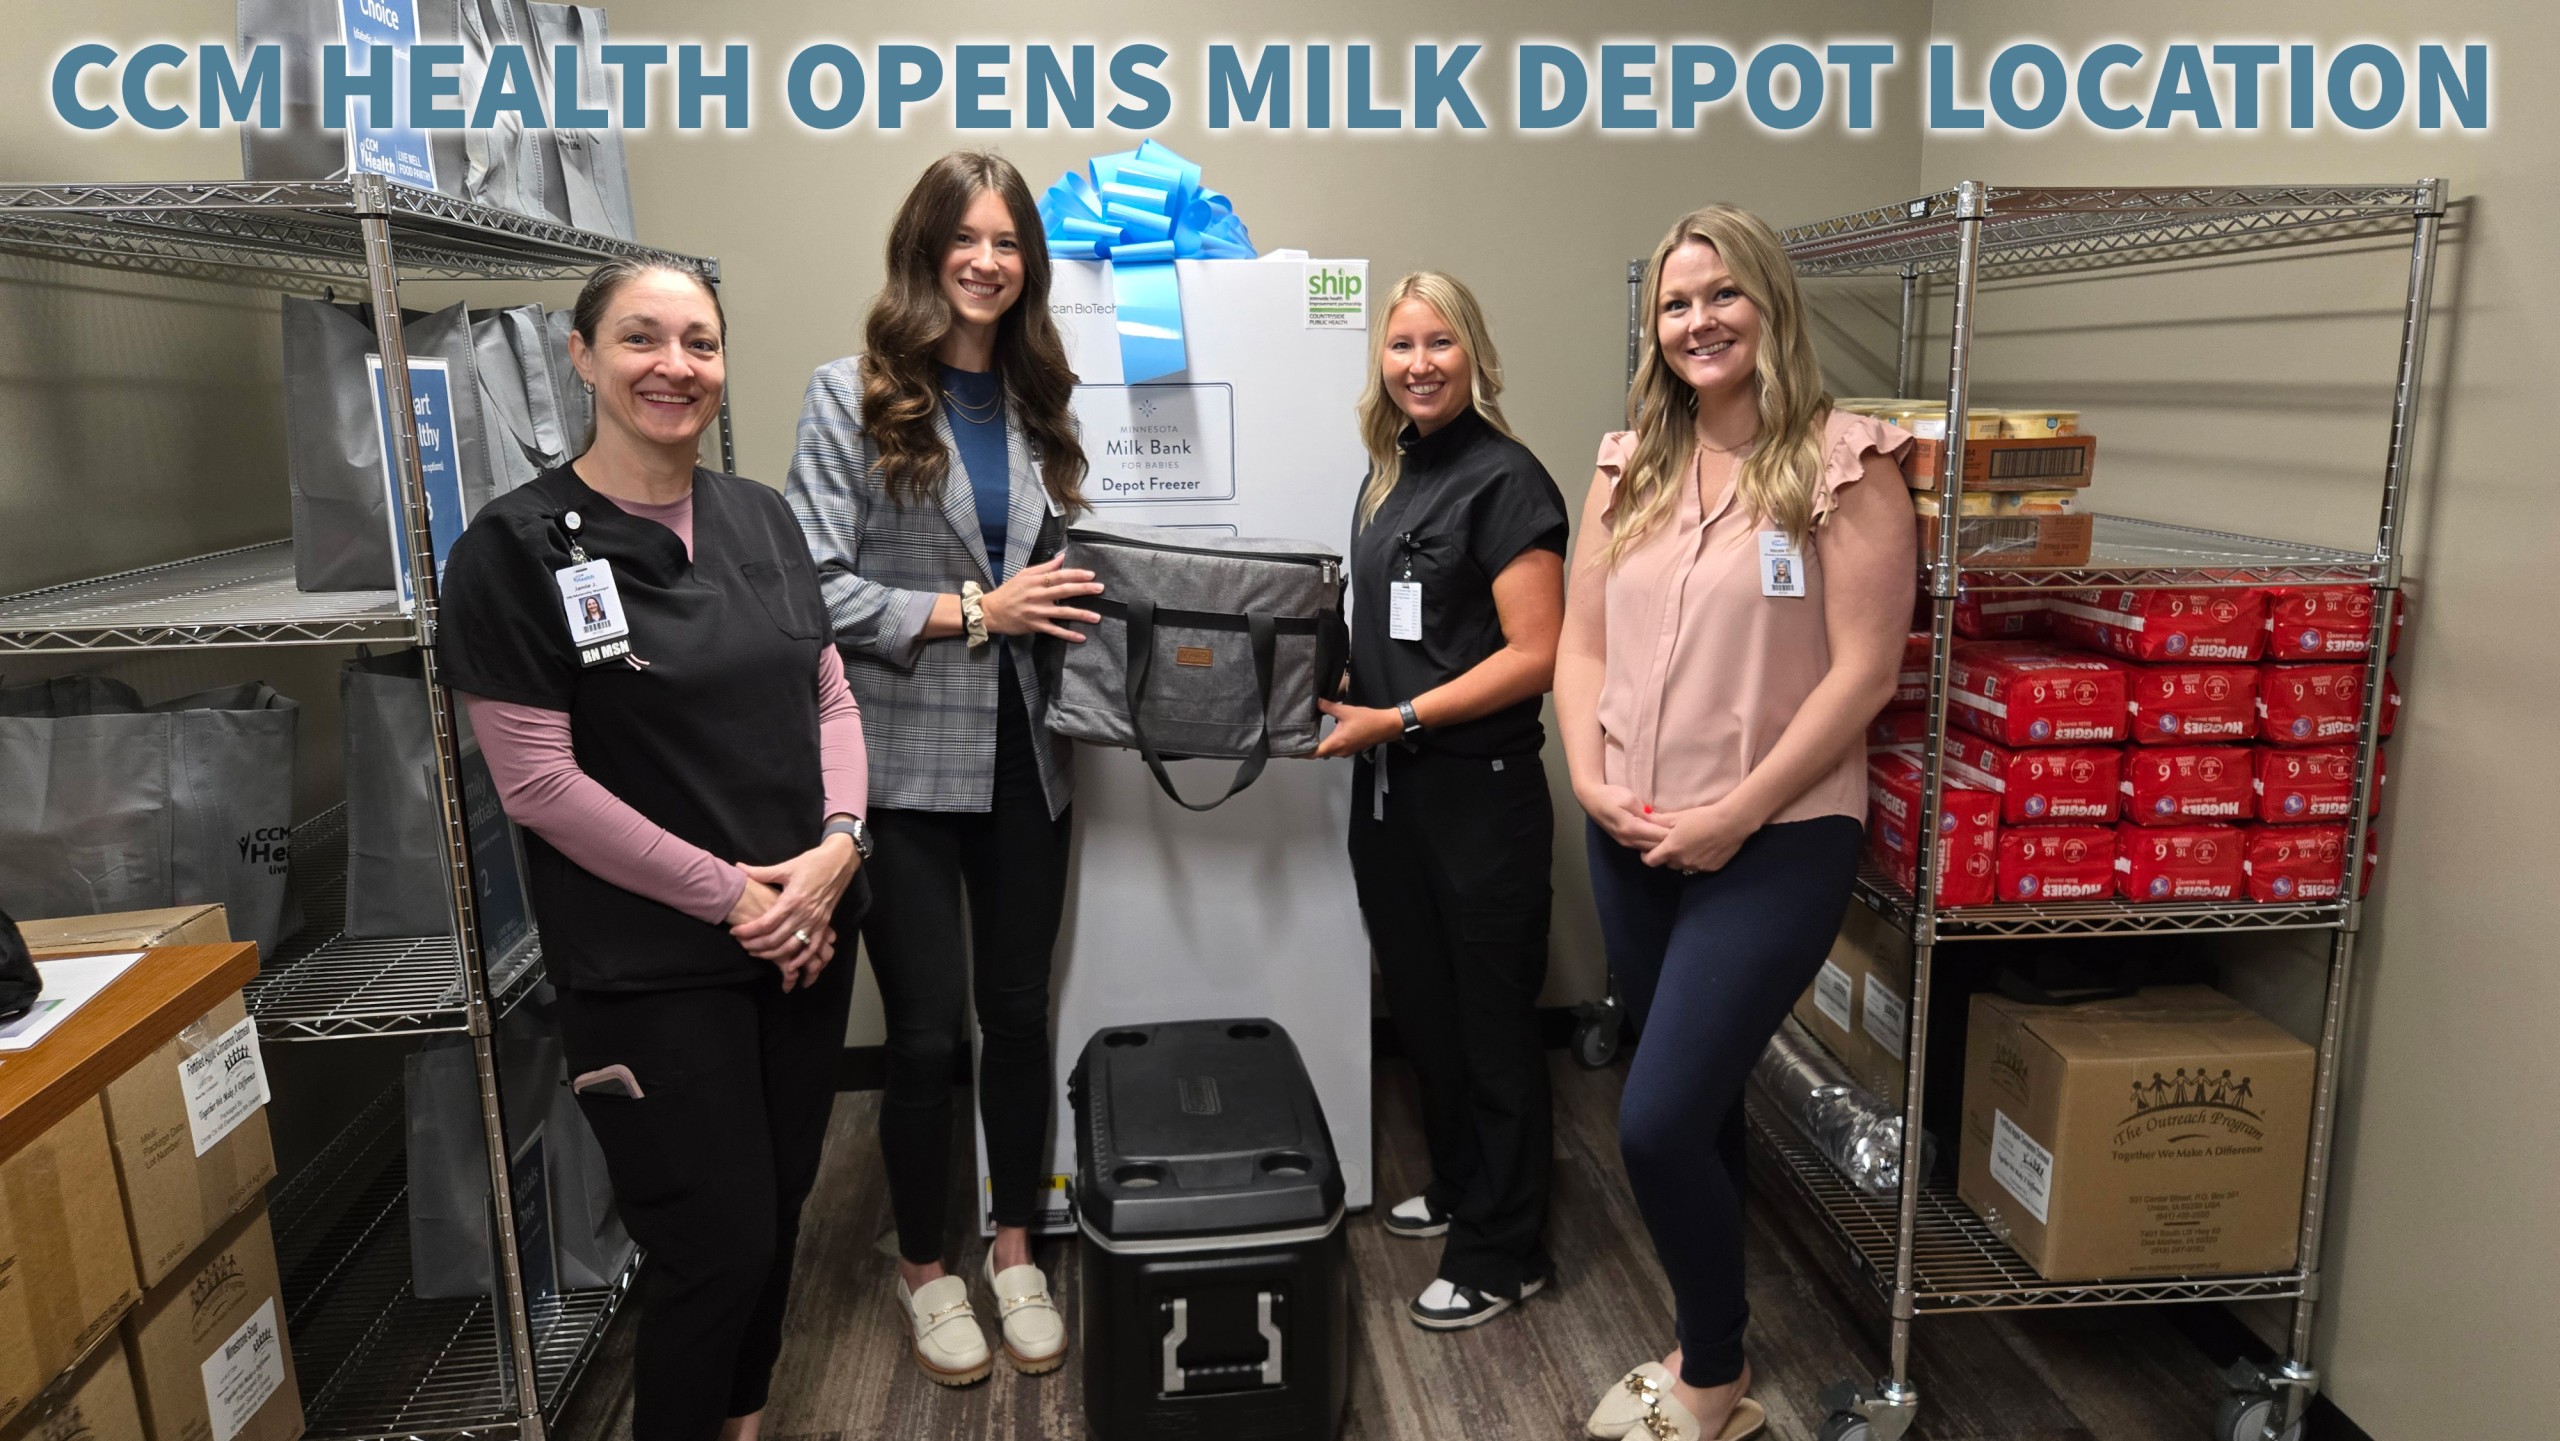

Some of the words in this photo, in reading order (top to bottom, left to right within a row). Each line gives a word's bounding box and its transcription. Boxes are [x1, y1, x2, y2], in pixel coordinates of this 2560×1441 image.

[365, 137, 379, 153] CCM
[364, 151, 396, 176] Health
[397, 150, 407, 162] LIVE
[407, 152, 421, 168] WELL
[398, 163, 414, 178] FOOD
[413, 165, 432, 183] PANTRY
[1309, 268, 1362, 300] ship
[1051, 304, 1074, 314] can
[412, 393, 432, 416] art
[417, 422, 440, 452] lthy
[1120, 425, 1179, 434] MINNESOTA
[1106, 439, 1145, 456] Milk
[1150, 439, 1192, 455] Bank
[1121, 462, 1142, 470] FOR
[1145, 461, 1180, 469] BABIES
[1102, 477, 1145, 495] Depot
[1150, 477, 1201, 490] Freezer
[2170, 600, 2183, 617] 6
[2191, 605, 2203, 615] 16
[2305, 599, 2317, 616] 6
[2326, 602, 2338, 611] 16
[582, 648, 601, 664] RN
[601, 639, 630, 658] MSN
[2189, 646, 2248, 659] HUGGIES
[2326, 640, 2369, 652] GGIES
[2033, 686, 2045, 704] 6
[2055, 689, 2066, 699] 16
[2162, 680, 2175, 699] 6
[2184, 684, 2196, 694] 16
[2294, 684, 2304, 701] 6
[2315, 686, 2327, 695] 16
[2055, 726, 2114, 740] HUGGIES
[2184, 721, 2243, 735] HUGGIES
[2317, 721, 2361, 737] GGIES
[2030, 763, 2043, 780] 6
[2052, 767, 2064, 777] 16
[2158, 764, 2171, 782] 6
[2180, 767, 2191, 776] 16
[2288, 761, 2300, 778] 6
[2309, 764, 2321, 774] 16
[468, 799, 499, 831] entials
[2050, 804, 2107, 817] HUGGIES
[2181, 801, 2239, 815] HUGGIES
[2309, 802, 2350, 815] GGIES
[1972, 813, 1987, 826] 6
[255, 826, 291, 841] CCM
[2023, 843, 2035, 860] 6
[2045, 847, 2055, 857] 16
[2155, 843, 2167, 861] 6
[2176, 848, 2186, 857] 16
[2278, 846, 2290, 862] 6
[2300, 848, 2311, 858] 16
[480, 868, 492, 898] 2
[2042, 883, 2101, 897] HUGGIES
[2174, 885, 2231, 897] HUGGIES
[2298, 885, 2342, 897] GGIES
[2113, 1125, 2143, 1146] The
[2146, 1109, 2207, 1132] Outreach
[2210, 1111, 2264, 1141] Program
[143, 1133, 170, 1154] Package
[2112, 1149, 2155, 1162] Together
[2158, 1149, 2175, 1159] We
[2176, 1149, 2204, 1159] Make
[2206, 1148, 2213, 1156] A
[2215, 1145, 2264, 1156] Difference
[146, 1158, 157, 1170] Lot
